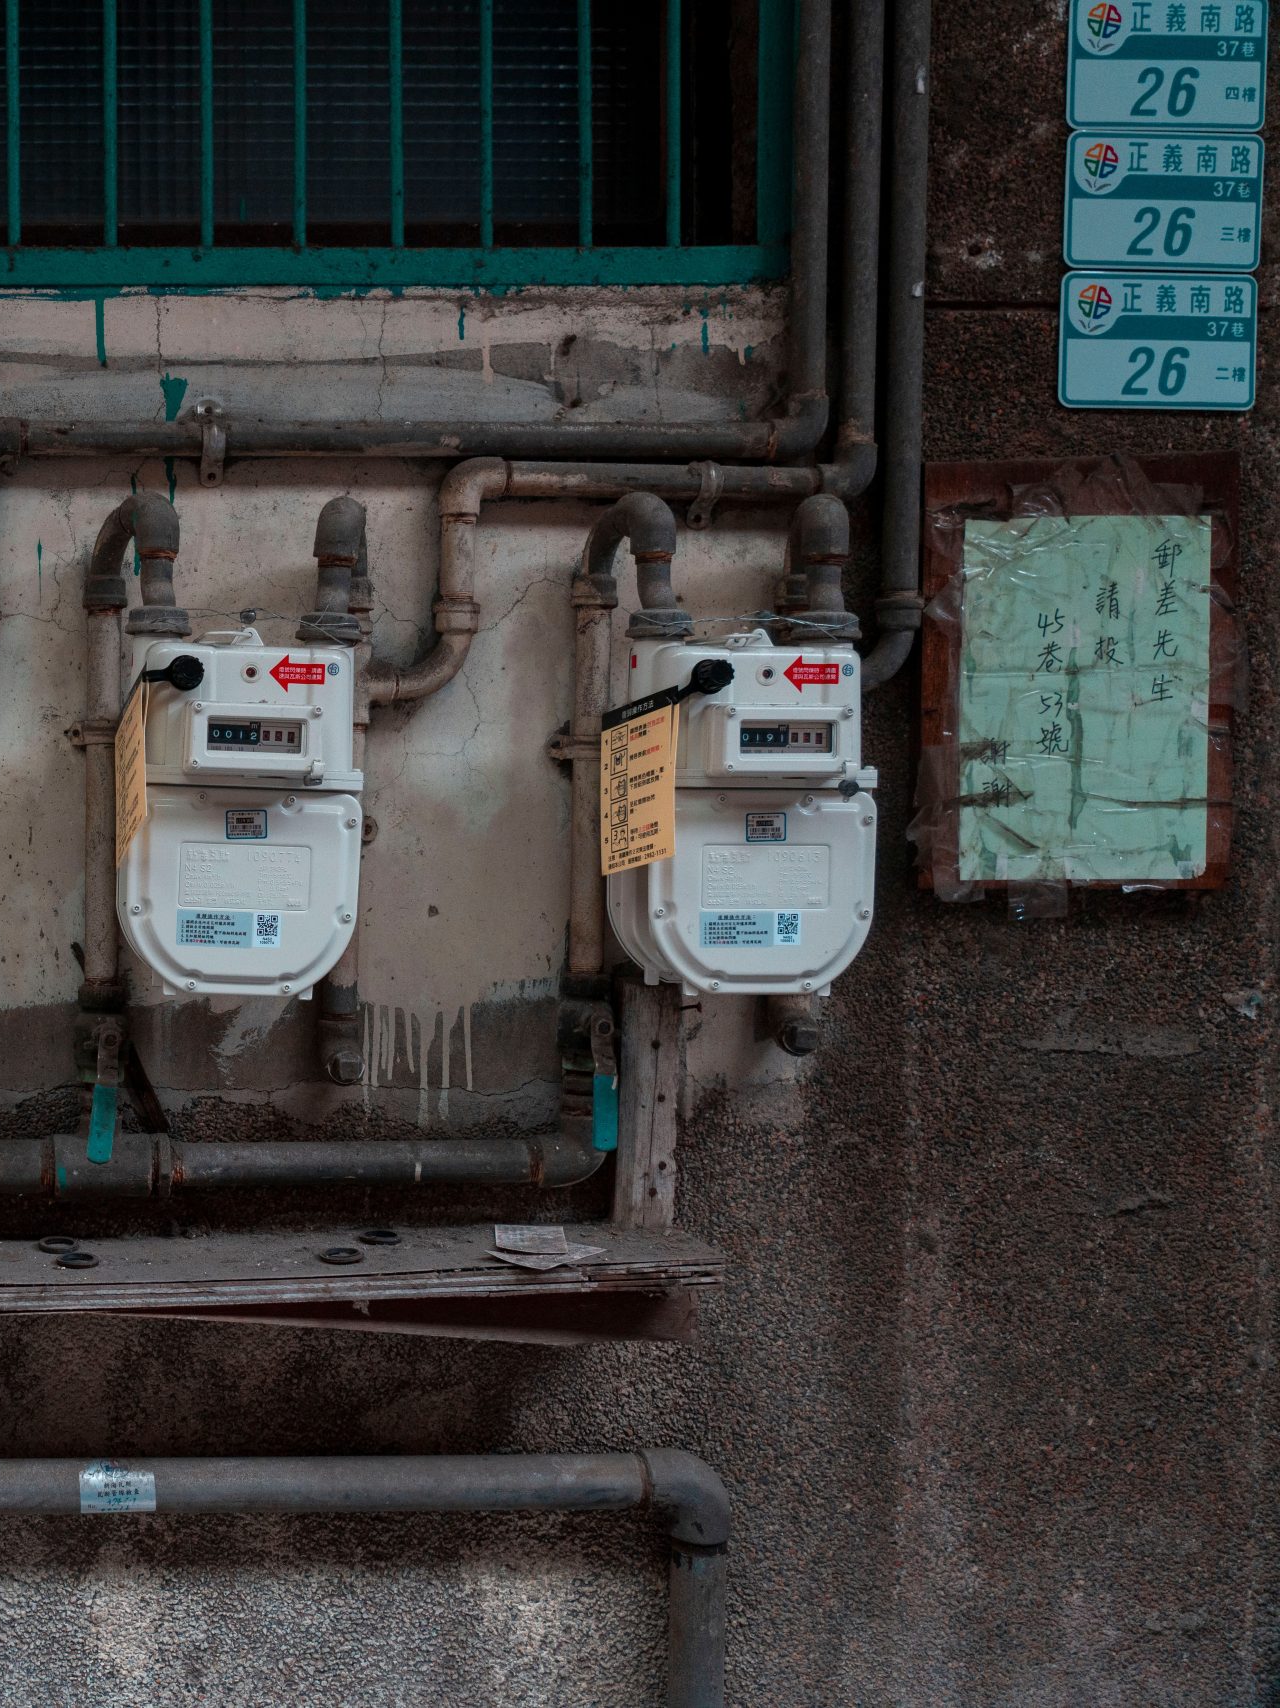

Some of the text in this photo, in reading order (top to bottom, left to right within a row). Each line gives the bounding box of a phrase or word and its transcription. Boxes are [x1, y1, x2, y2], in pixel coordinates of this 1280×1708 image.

[1130, 2, 1255, 33] 正義南路
[1217, 41, 1255, 57] 37巷
[1130, 66, 1256, 117] 26 四樓
[1127, 141, 1252, 174] 正義南路
[1213, 182, 1251, 198] 37巷
[1126, 206, 1251, 257] 26 三樓
[1121, 282, 1244, 315] 正義南路
[1207, 321, 1245, 338] 37巷
[1121, 346, 1246, 397] 26 二樓
[1094, 581, 1124, 665] 請投
[1151, 538, 1183, 702] 郵差先生
[212, 729, 257, 740] 0012
